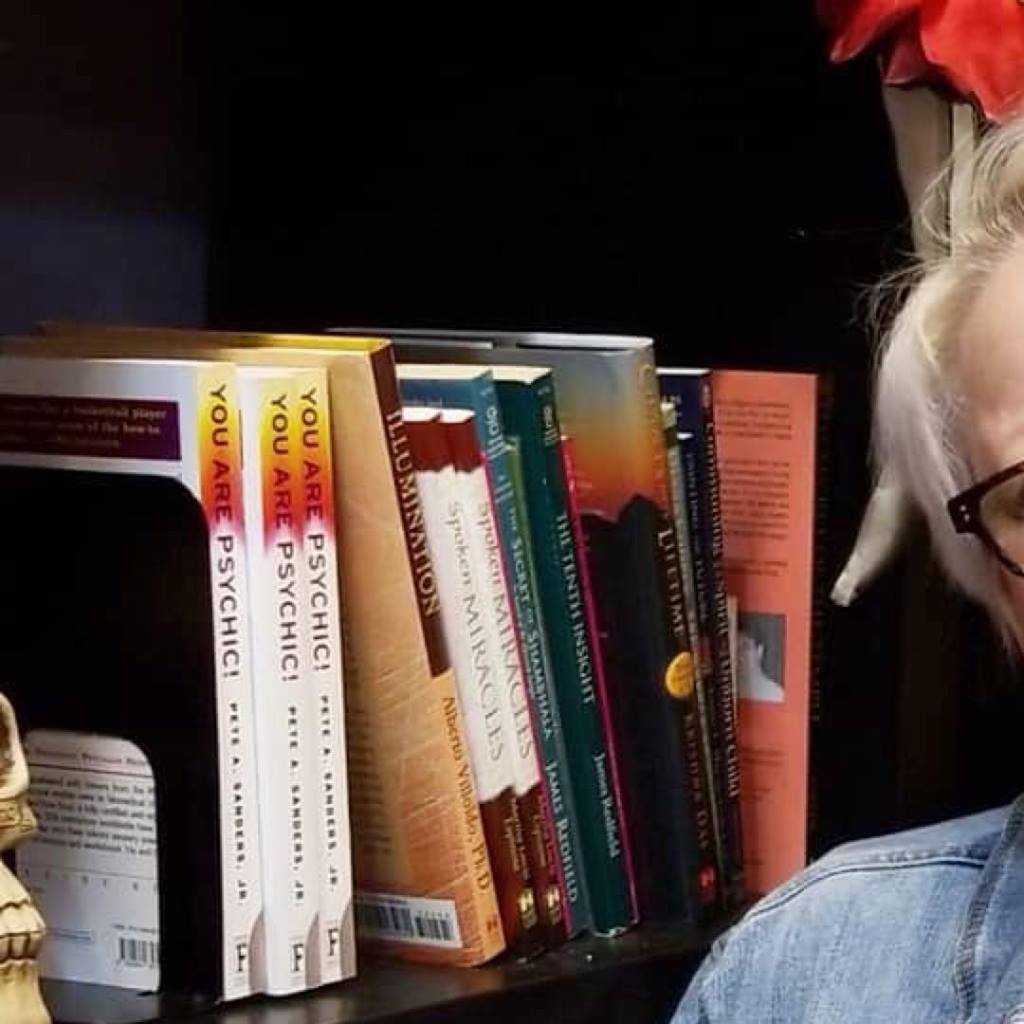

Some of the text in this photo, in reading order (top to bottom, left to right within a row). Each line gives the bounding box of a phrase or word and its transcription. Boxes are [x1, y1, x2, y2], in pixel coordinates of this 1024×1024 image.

[209, 384, 241, 678] YOU ARE PSYCHIC!
[271, 394, 299, 682] YOU ARE PSYCHIC!
[300, 388, 331, 671] YOU ARE PSYCHIC!
[386, 411, 440, 617] ILLUMINATION
[448, 500, 502, 761] Spoken MIRACLES
[479, 498, 503, 587] Spoken
[496, 592, 532, 759] MIRACLES
[229, 703, 240, 747] PETE
[288, 706, 299, 749] PETE
[320, 695, 331, 737] PETE
[442, 697, 463, 764] Alberto
